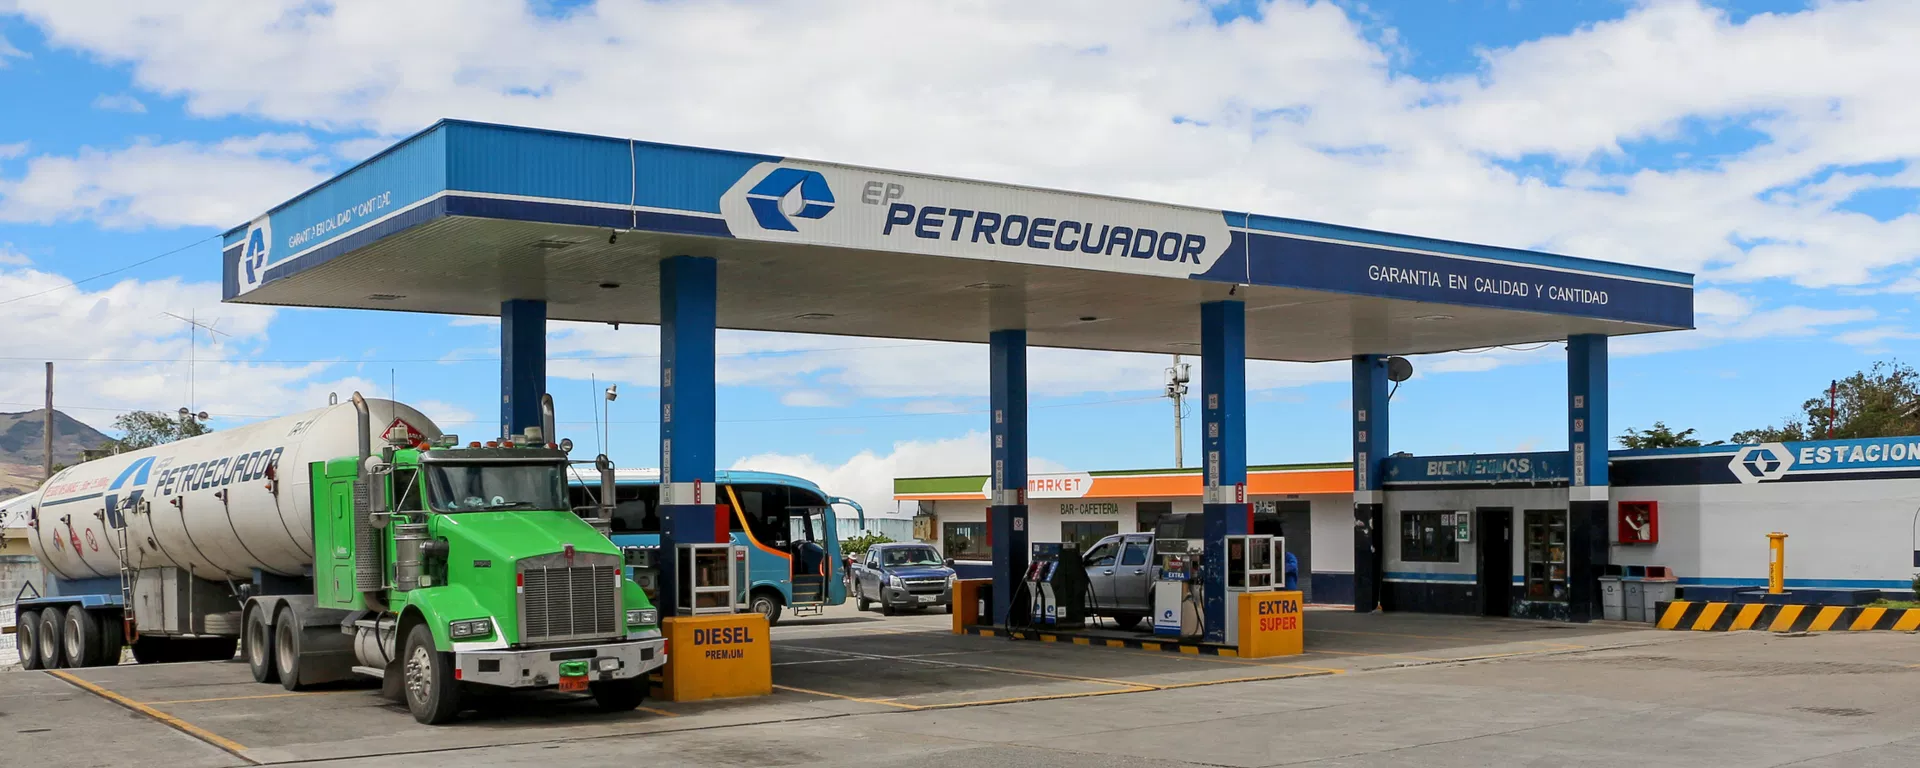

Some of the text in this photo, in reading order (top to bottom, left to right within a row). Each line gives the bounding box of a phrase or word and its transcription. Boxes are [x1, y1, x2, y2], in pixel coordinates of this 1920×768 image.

[862, 180, 905, 206] EP
[288, 225, 316, 248] GARANTA
[358, 190, 392, 217] CANTDAD
[882, 203, 1206, 265] PETROECUADOR
[1368, 264, 1608, 305] GARANTIA EN CALIDAD Y CANTIDAD
[1799, 442, 1920, 465] ESTACION
[154, 446, 285, 497] PETROECUADOR
[1028, 478, 1081, 492] MARKET
[1258, 600, 1298, 615] EXTRA
[694, 627, 754, 645] DIESEL
[1260, 616, 1297, 632] SUPER
